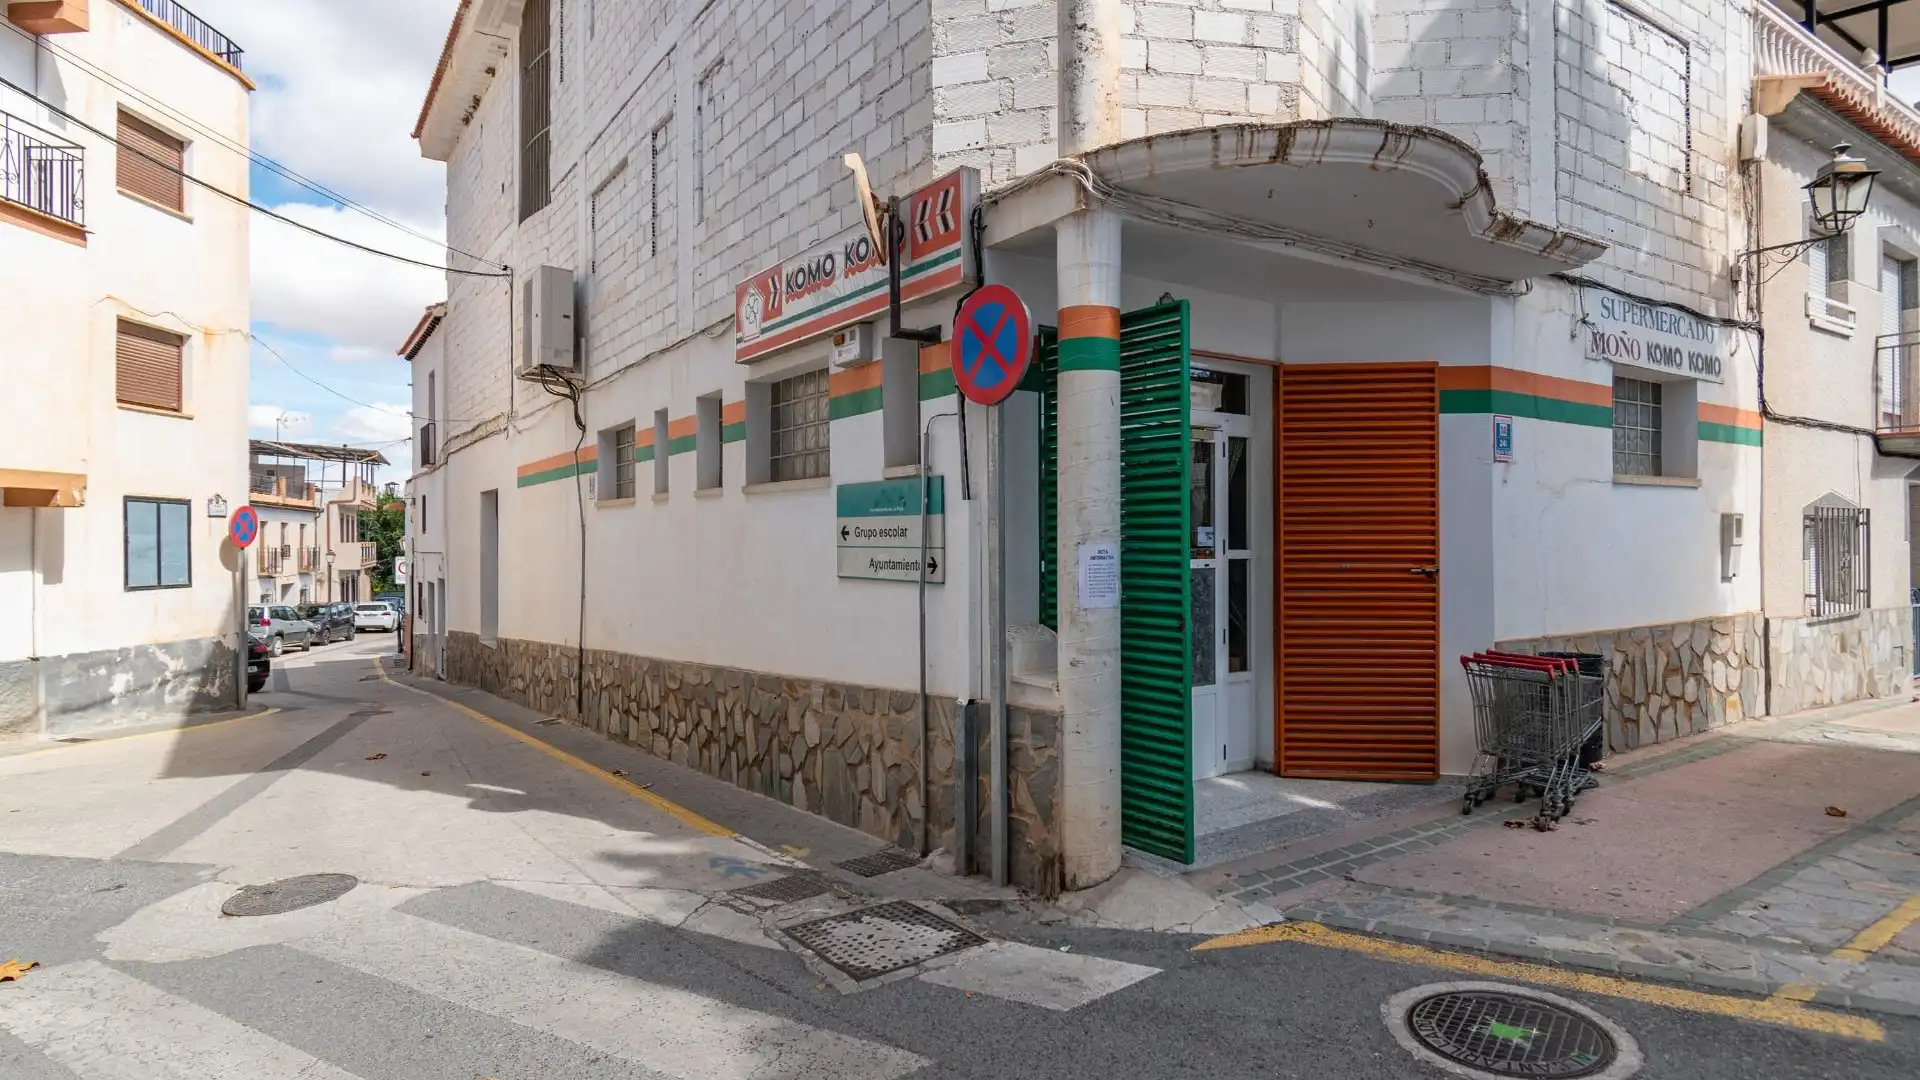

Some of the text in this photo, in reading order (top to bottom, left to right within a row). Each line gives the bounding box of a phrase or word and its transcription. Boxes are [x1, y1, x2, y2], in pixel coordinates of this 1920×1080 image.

[785, 253, 835, 295] KOMO
[1600, 296, 1714, 344] SUPERMERCADO
[1591, 330, 1722, 377] MOÑO KOMO KOMO
[854, 525, 908, 540] Grupo escolar
